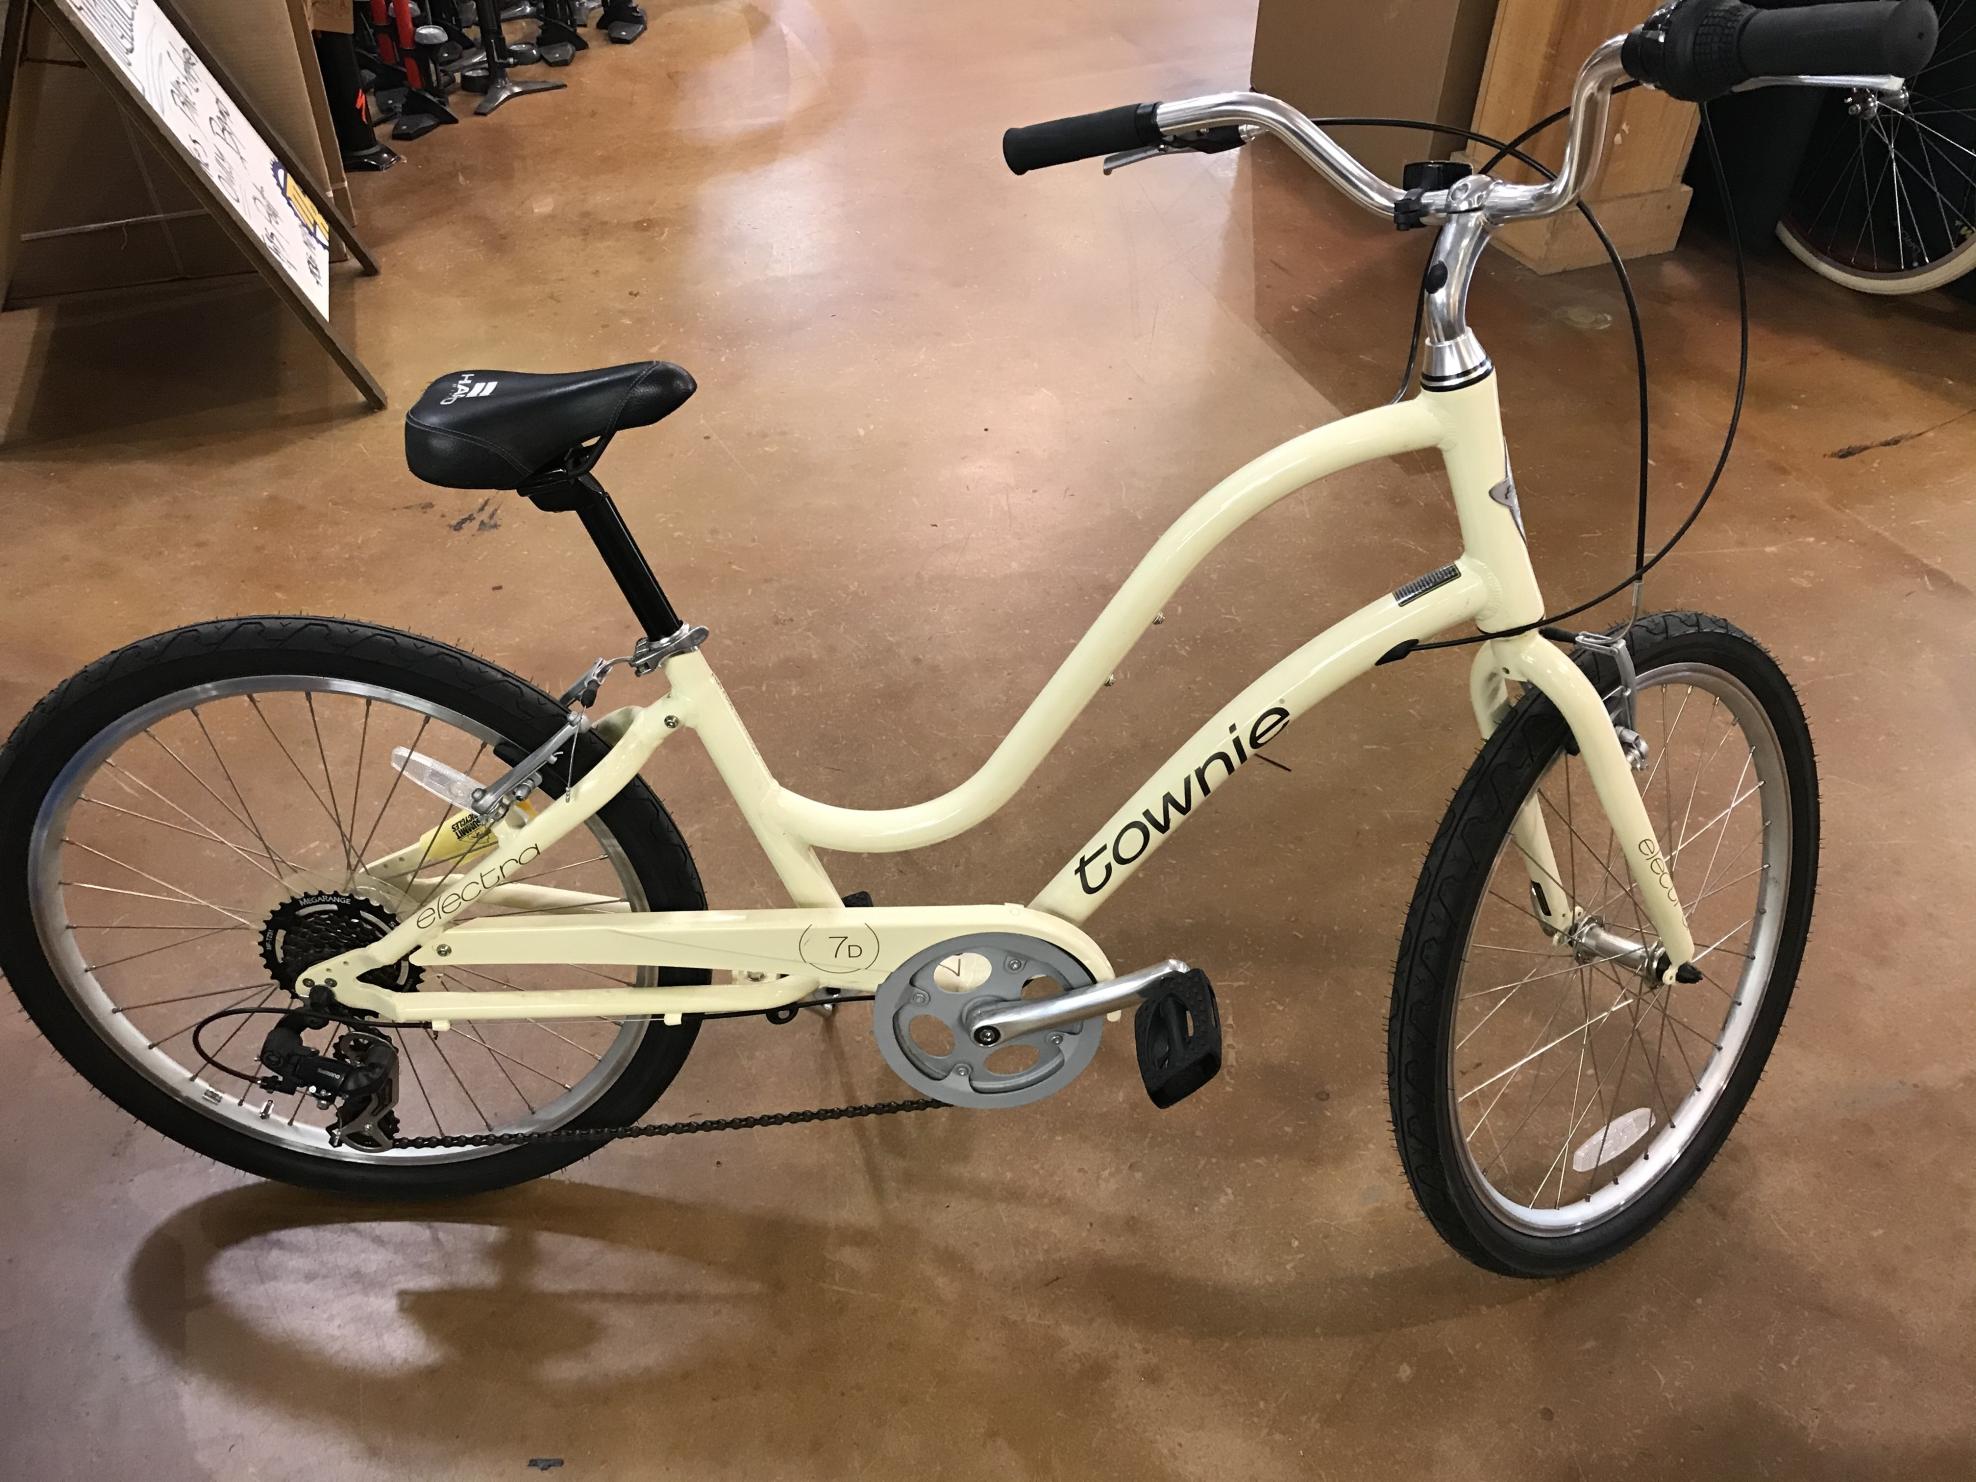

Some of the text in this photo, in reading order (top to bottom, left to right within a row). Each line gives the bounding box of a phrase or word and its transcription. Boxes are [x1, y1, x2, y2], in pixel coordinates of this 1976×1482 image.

[1074, 706, 1290, 894] townie
[417, 843, 540, 929] electra
[828, 936, 863, 959] 7D
